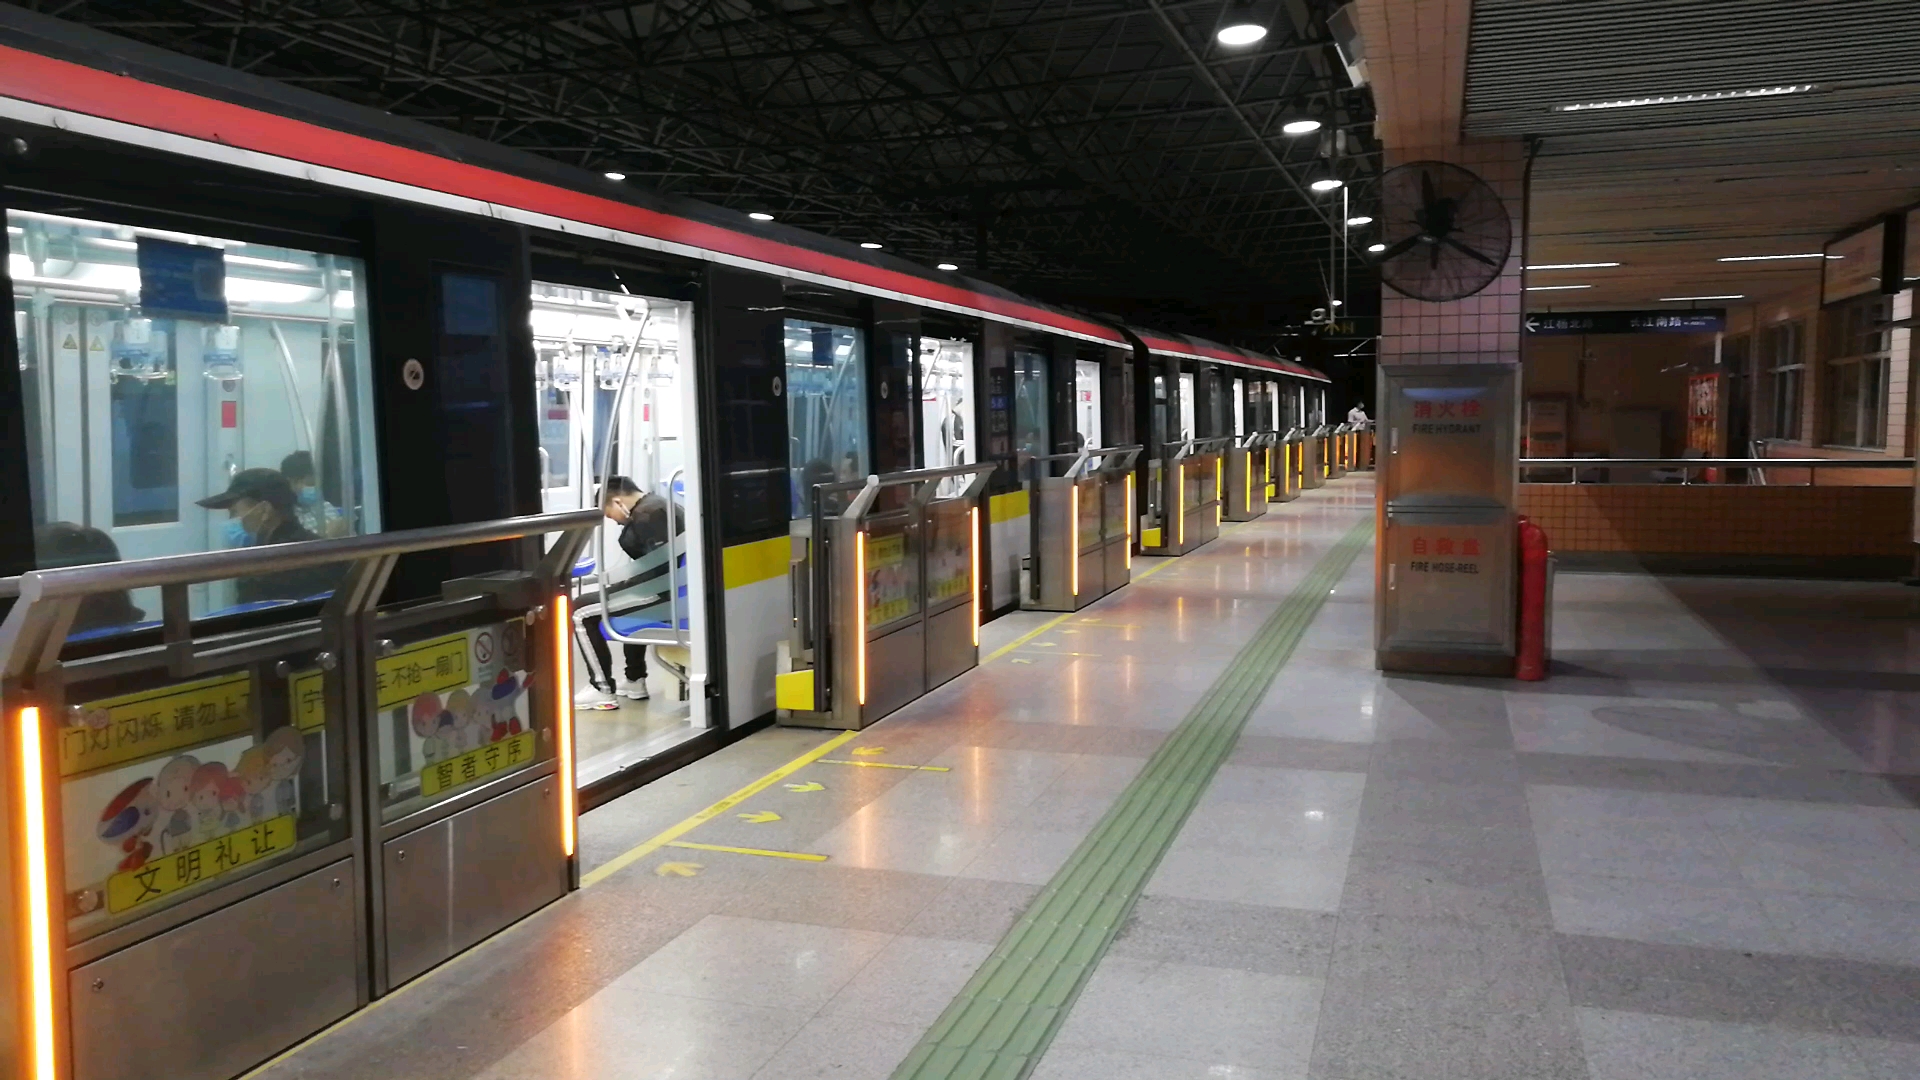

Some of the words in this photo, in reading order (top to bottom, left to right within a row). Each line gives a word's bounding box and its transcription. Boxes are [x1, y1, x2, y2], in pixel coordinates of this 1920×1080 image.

[1414, 399, 1481, 418] 消火栓
[1412, 423, 1434, 434] FIRE
[1435, 423, 1482, 434] HYDRANT
[1411, 561, 1429, 572] FIRE
[1432, 562, 1479, 574] HOSE-REEL
[437, 739, 521, 790] 智者守序
[134, 824, 275, 902] 文明礼让
